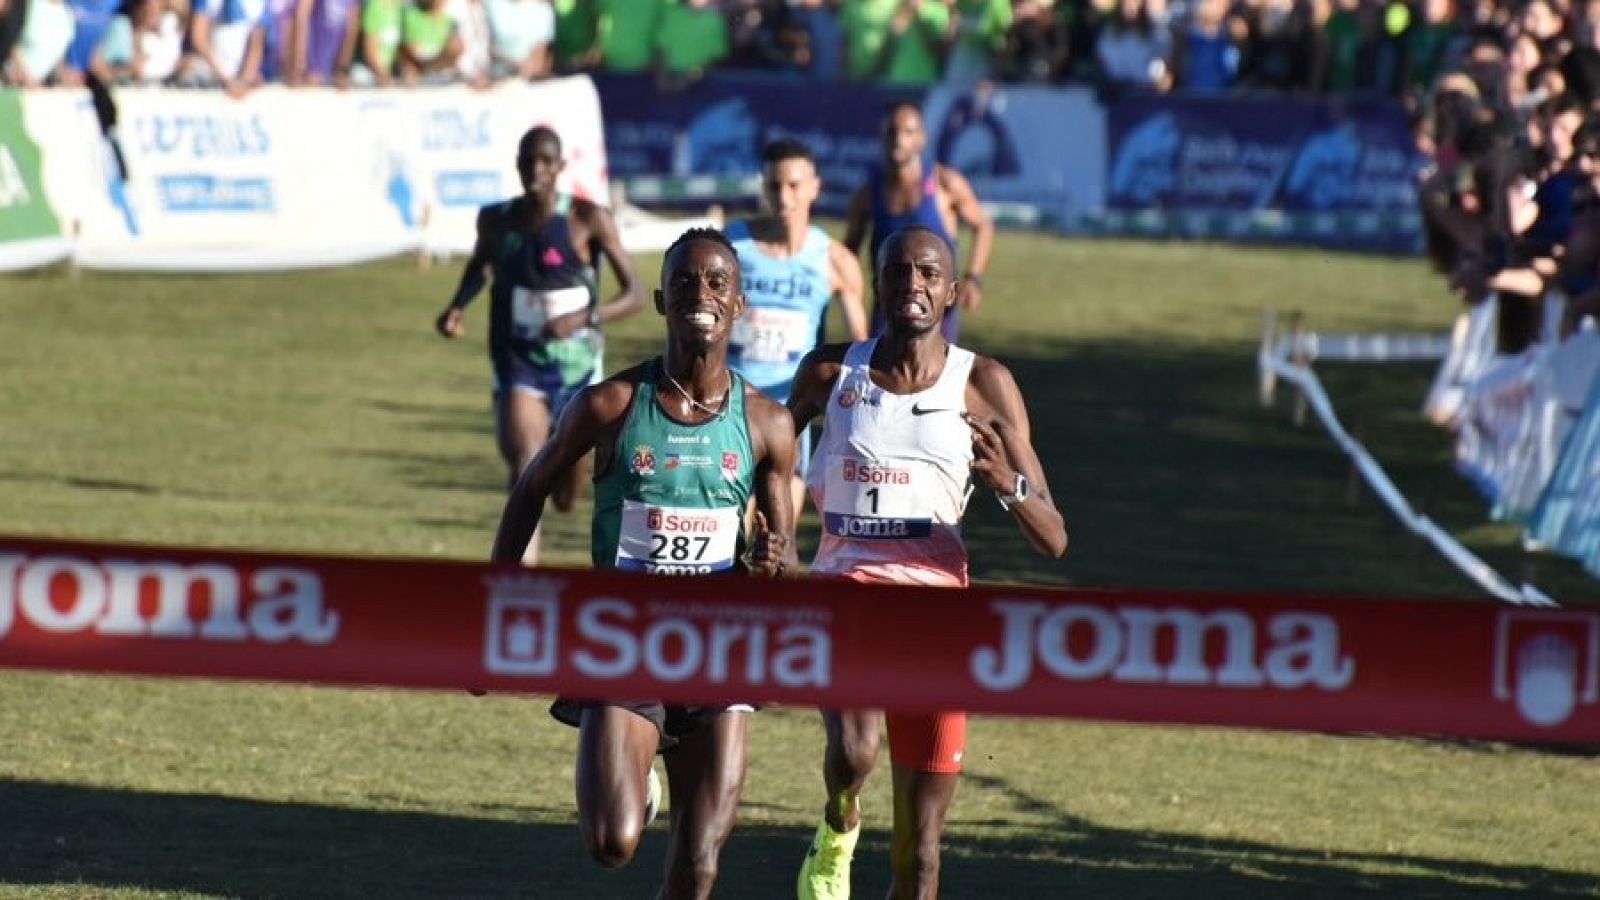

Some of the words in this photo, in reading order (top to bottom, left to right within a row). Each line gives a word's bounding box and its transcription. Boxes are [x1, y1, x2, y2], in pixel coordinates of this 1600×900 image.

[857, 464, 911, 484] Soria
[865, 488, 879, 515] 1
[665, 514, 719, 533] Soria
[649, 534, 712, 561] 287
[571, 597, 833, 688] Soria
[970, 600, 1356, 692] Joma
